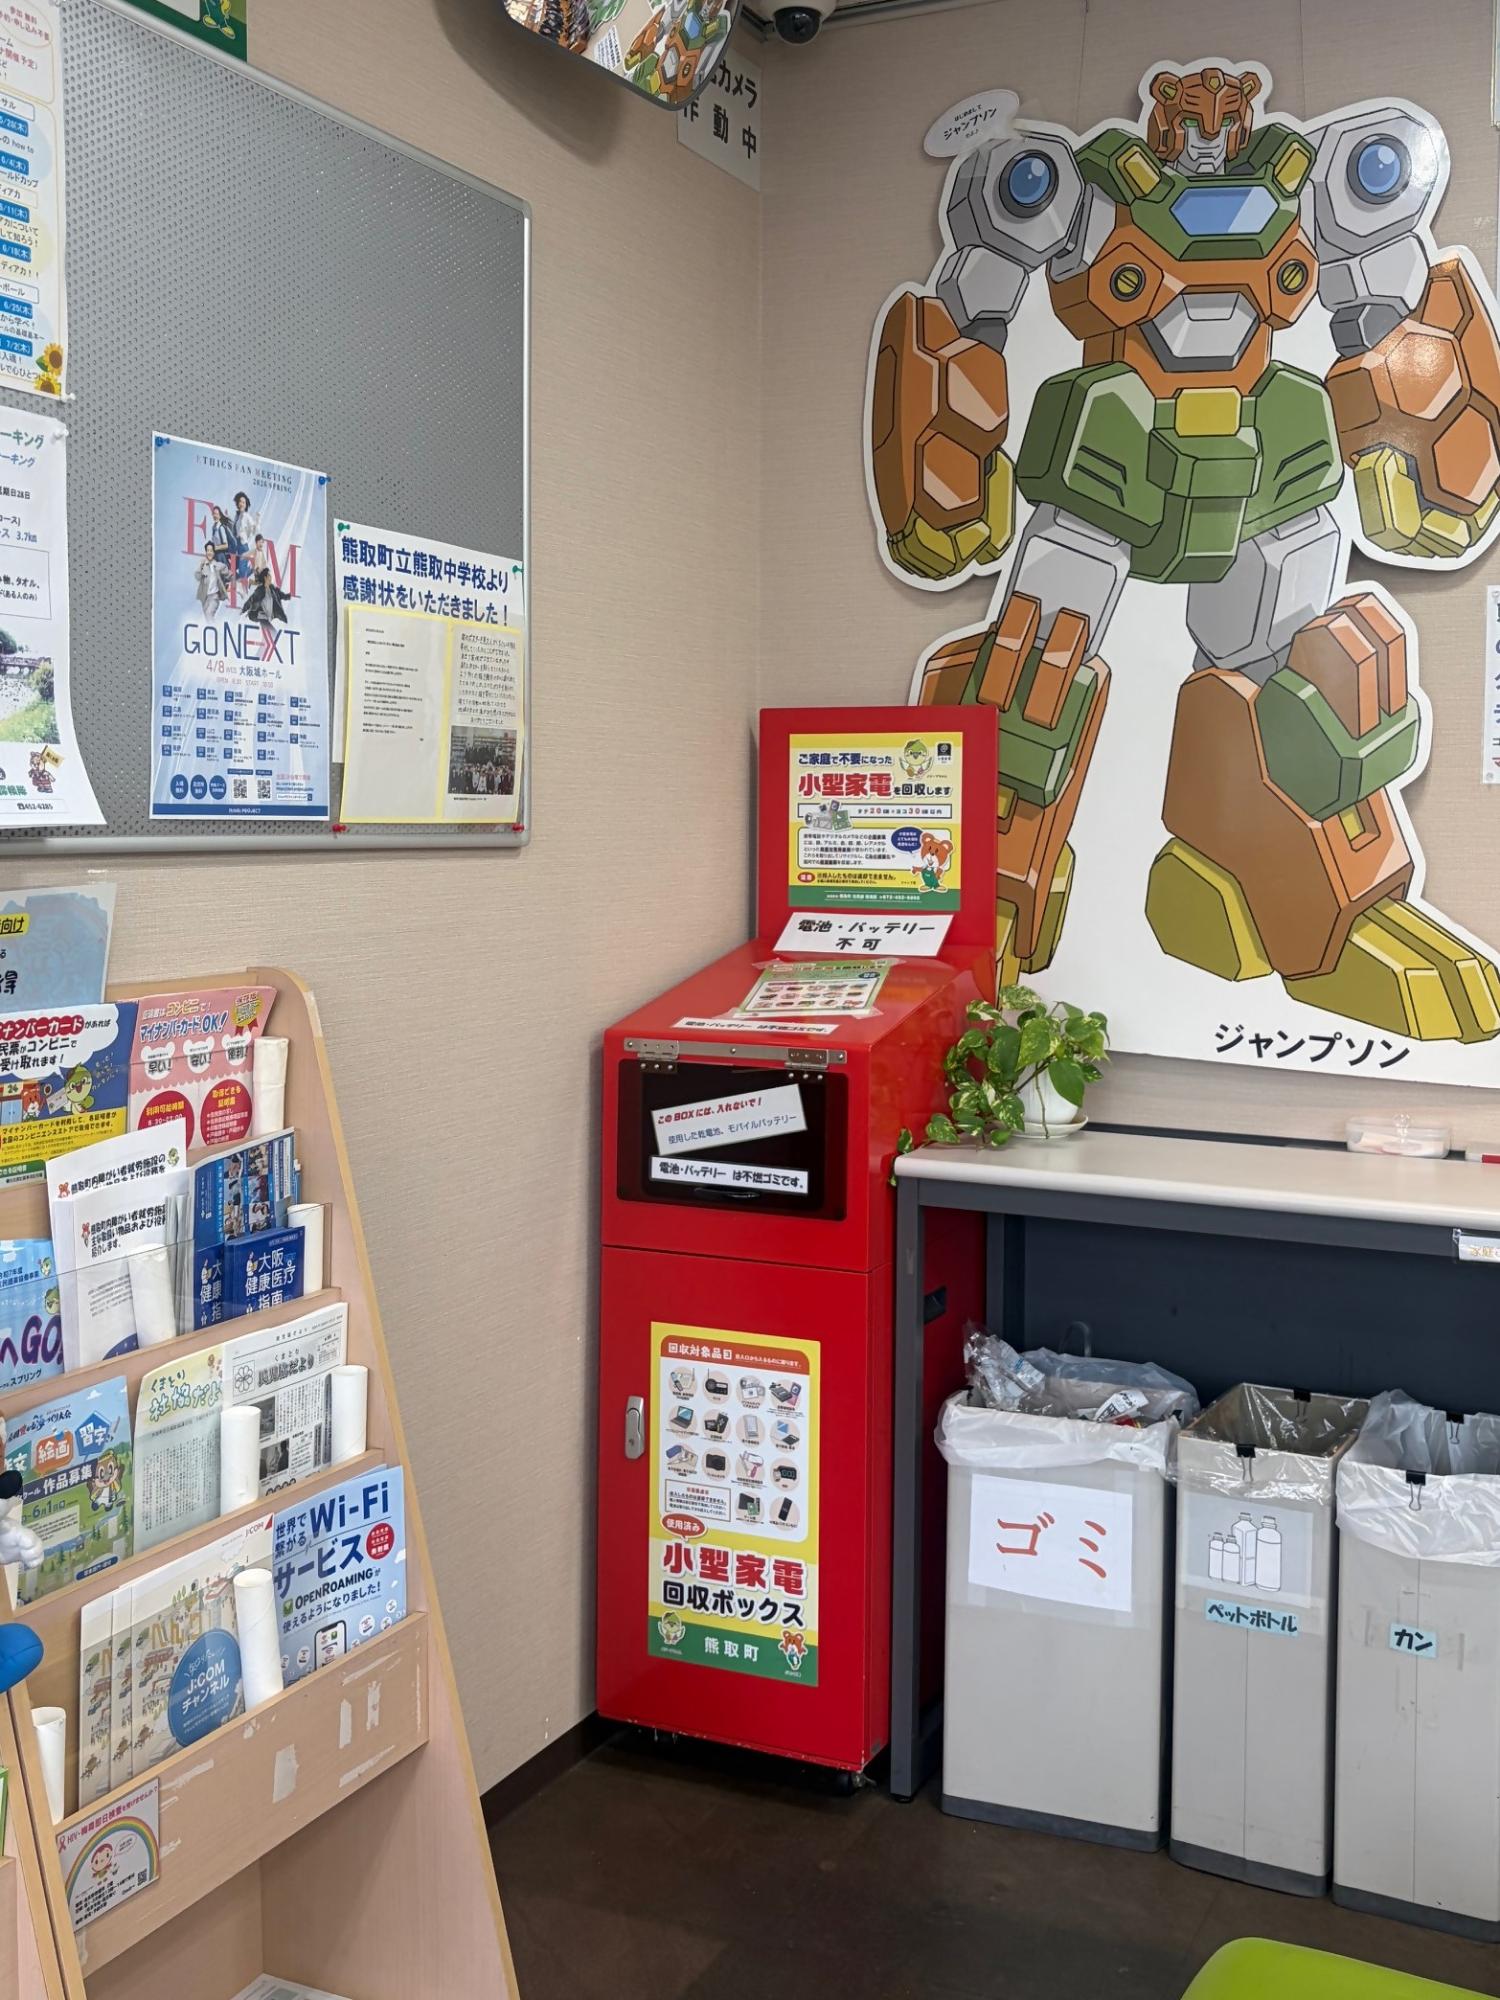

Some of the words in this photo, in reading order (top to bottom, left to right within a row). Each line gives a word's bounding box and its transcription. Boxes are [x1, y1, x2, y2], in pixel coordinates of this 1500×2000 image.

[711, 59, 758, 109] カメラ
[944, 107, 998, 141] ジャンプソン
[342, 536, 509, 594] 熊取町立熊取中学校より
[343, 574, 508, 626] 感謝状をいただきました!
[239, 664, 283, 680] 大阪城ホール
[798, 753, 893, 765] ご家庭で不要になった
[0, 916, 25, 934] 向け
[798, 919, 936, 934] 電池・バッテリー
[1215, 1024, 1410, 1069] ジャンプソン
[659, 1161, 728, 1179] 電池・バッテリー
[733, 1171, 804, 1189] は不燃ゴミです。
[258, 1247, 285, 1272] 大阪
[668, 1342, 733, 1361] 回収対象品目
[151, 1369, 185, 1392] くまとり
[79, 1422, 110, 1447] 習字
[38, 1440, 70, 1463] 絵画
[43, 1463, 94, 1497] 作品募集
[310, 1481, 389, 1539] Wi-Fi
[276, 1512, 307, 1540] 世界で
[666, 1518, 701, 1532] 使用済み
[275, 1532, 307, 1559] 繋がる
[996, 1511, 1107, 1580] ゴミ
[274, 1533, 364, 1600] サービス
[663, 1542, 804, 1597] 小型家電
[282, 1580, 381, 1634] 使えるようになりました!
[663, 1580, 805, 1628] 回収ボックス
[1207, 1603, 1298, 1633] ペットボトル
[704, 1636, 760, 1663] 熊取町
[1394, 1628, 1433, 1652] カン
[187, 1658, 226, 1695] J:COM
[182, 1674, 230, 1716] チャンネル
